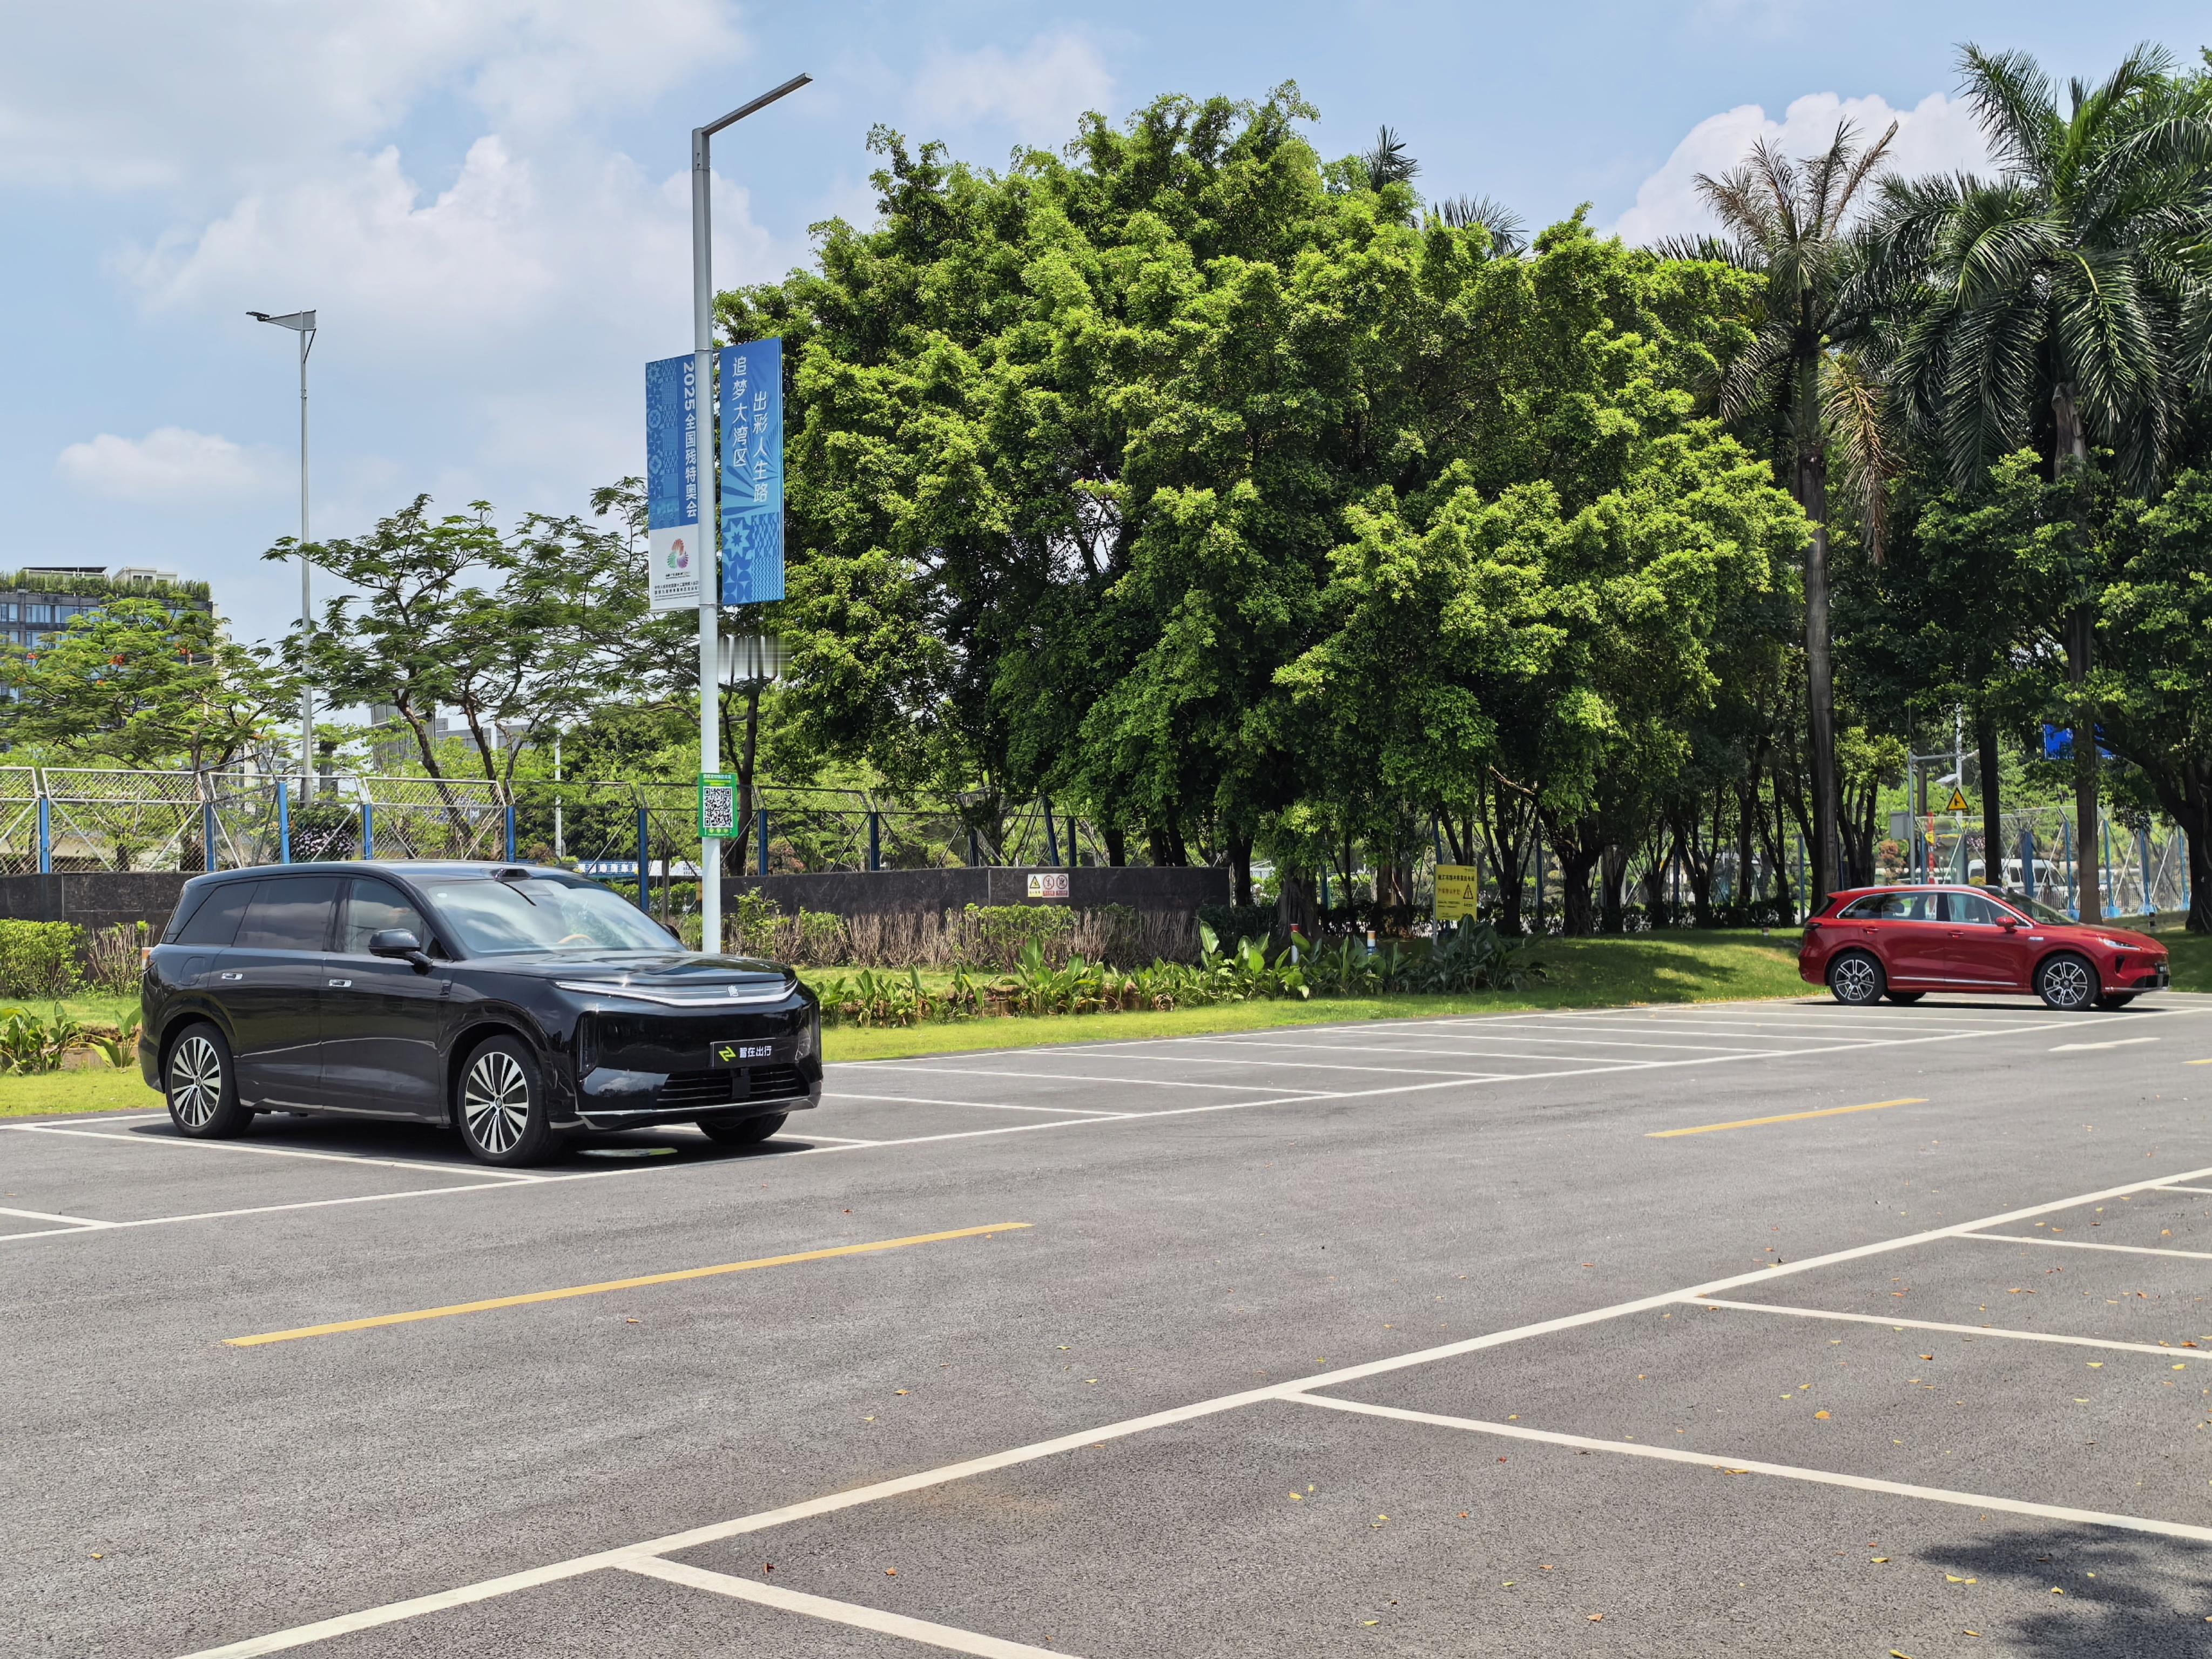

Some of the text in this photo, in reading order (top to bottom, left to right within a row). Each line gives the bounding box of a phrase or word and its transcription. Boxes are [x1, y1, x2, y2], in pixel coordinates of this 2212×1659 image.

[683, 361, 697, 518] 2025全国残特奥会
[732, 356, 748, 467] 追梦大湾区
[753, 391, 768, 503] 出彩人生路
[739, 1046, 772, 1058] 智在出行
